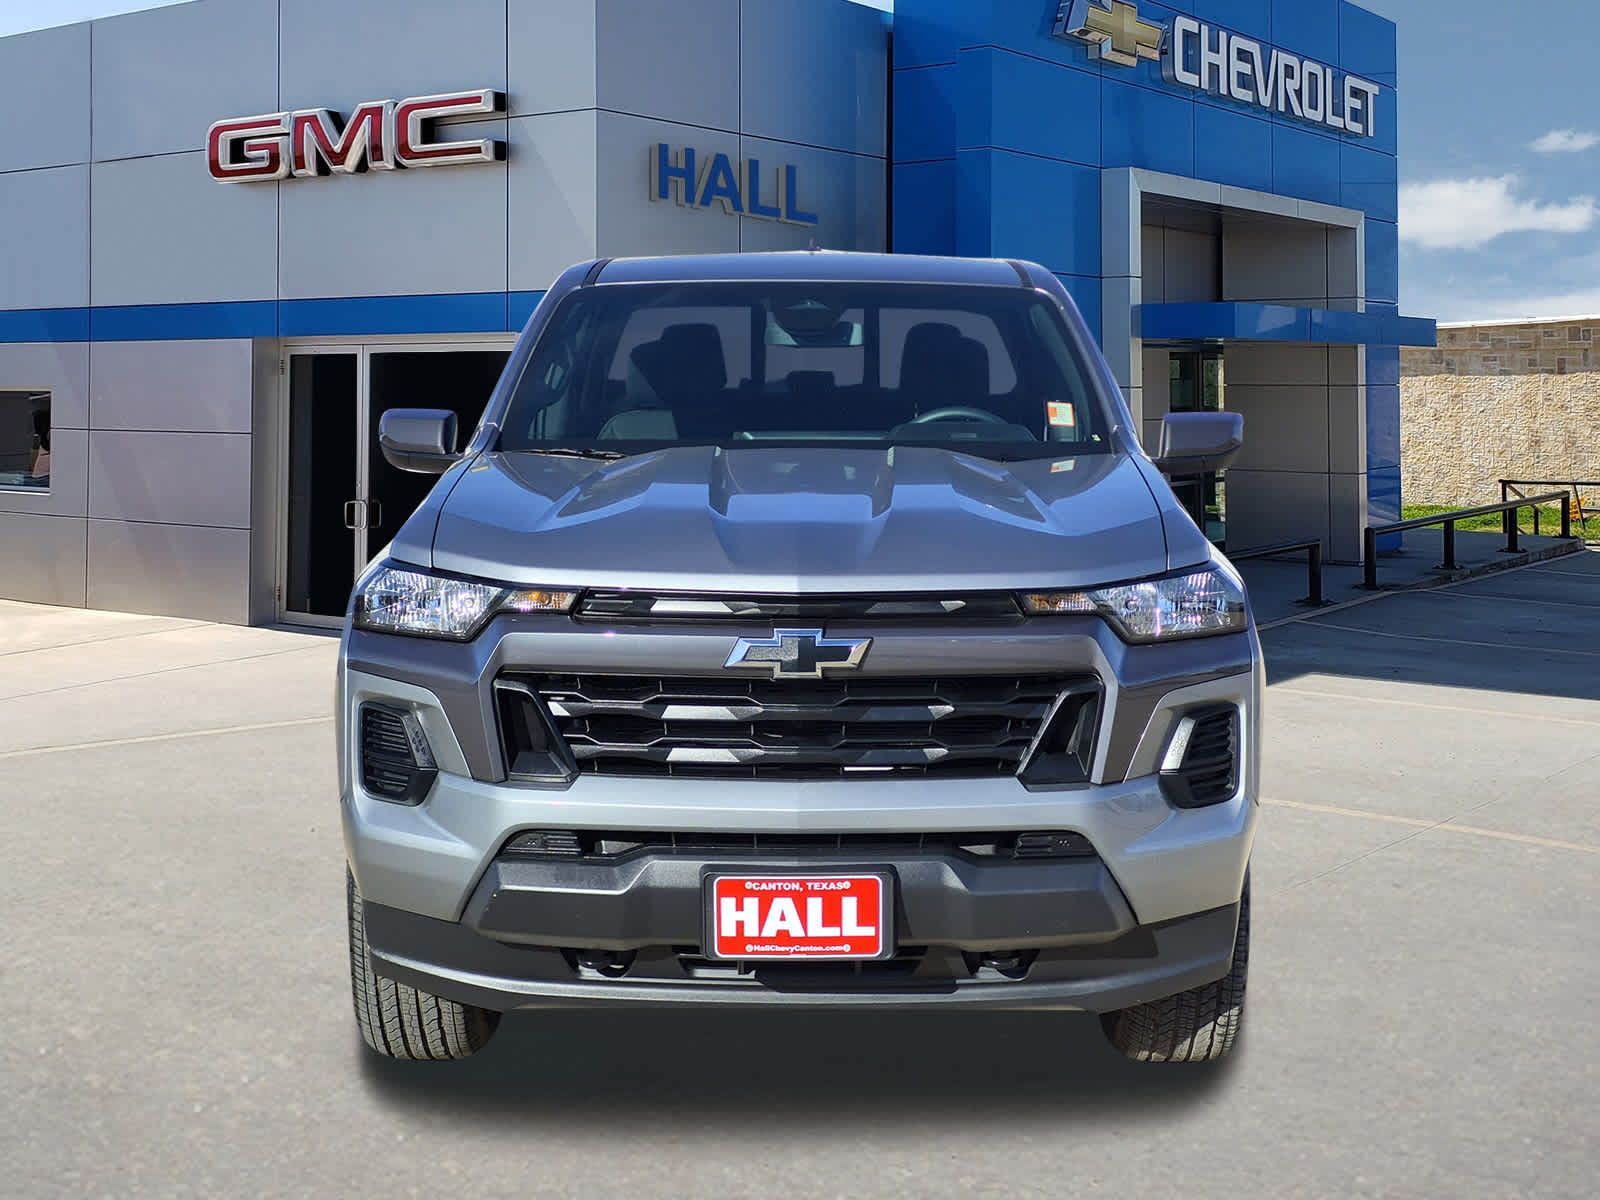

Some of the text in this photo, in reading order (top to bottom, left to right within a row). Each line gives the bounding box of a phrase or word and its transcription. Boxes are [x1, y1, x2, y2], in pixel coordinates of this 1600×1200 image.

[1173, 15, 1380, 137] CHEVROLET
[206, 88, 508, 185] GMC
[652, 142, 818, 226] HALL
[720, 896, 876, 937] HALL
[753, 881, 842, 892] CANTON, TEXAS
[753, 944, 843, 954] HallChevyCanton.com
